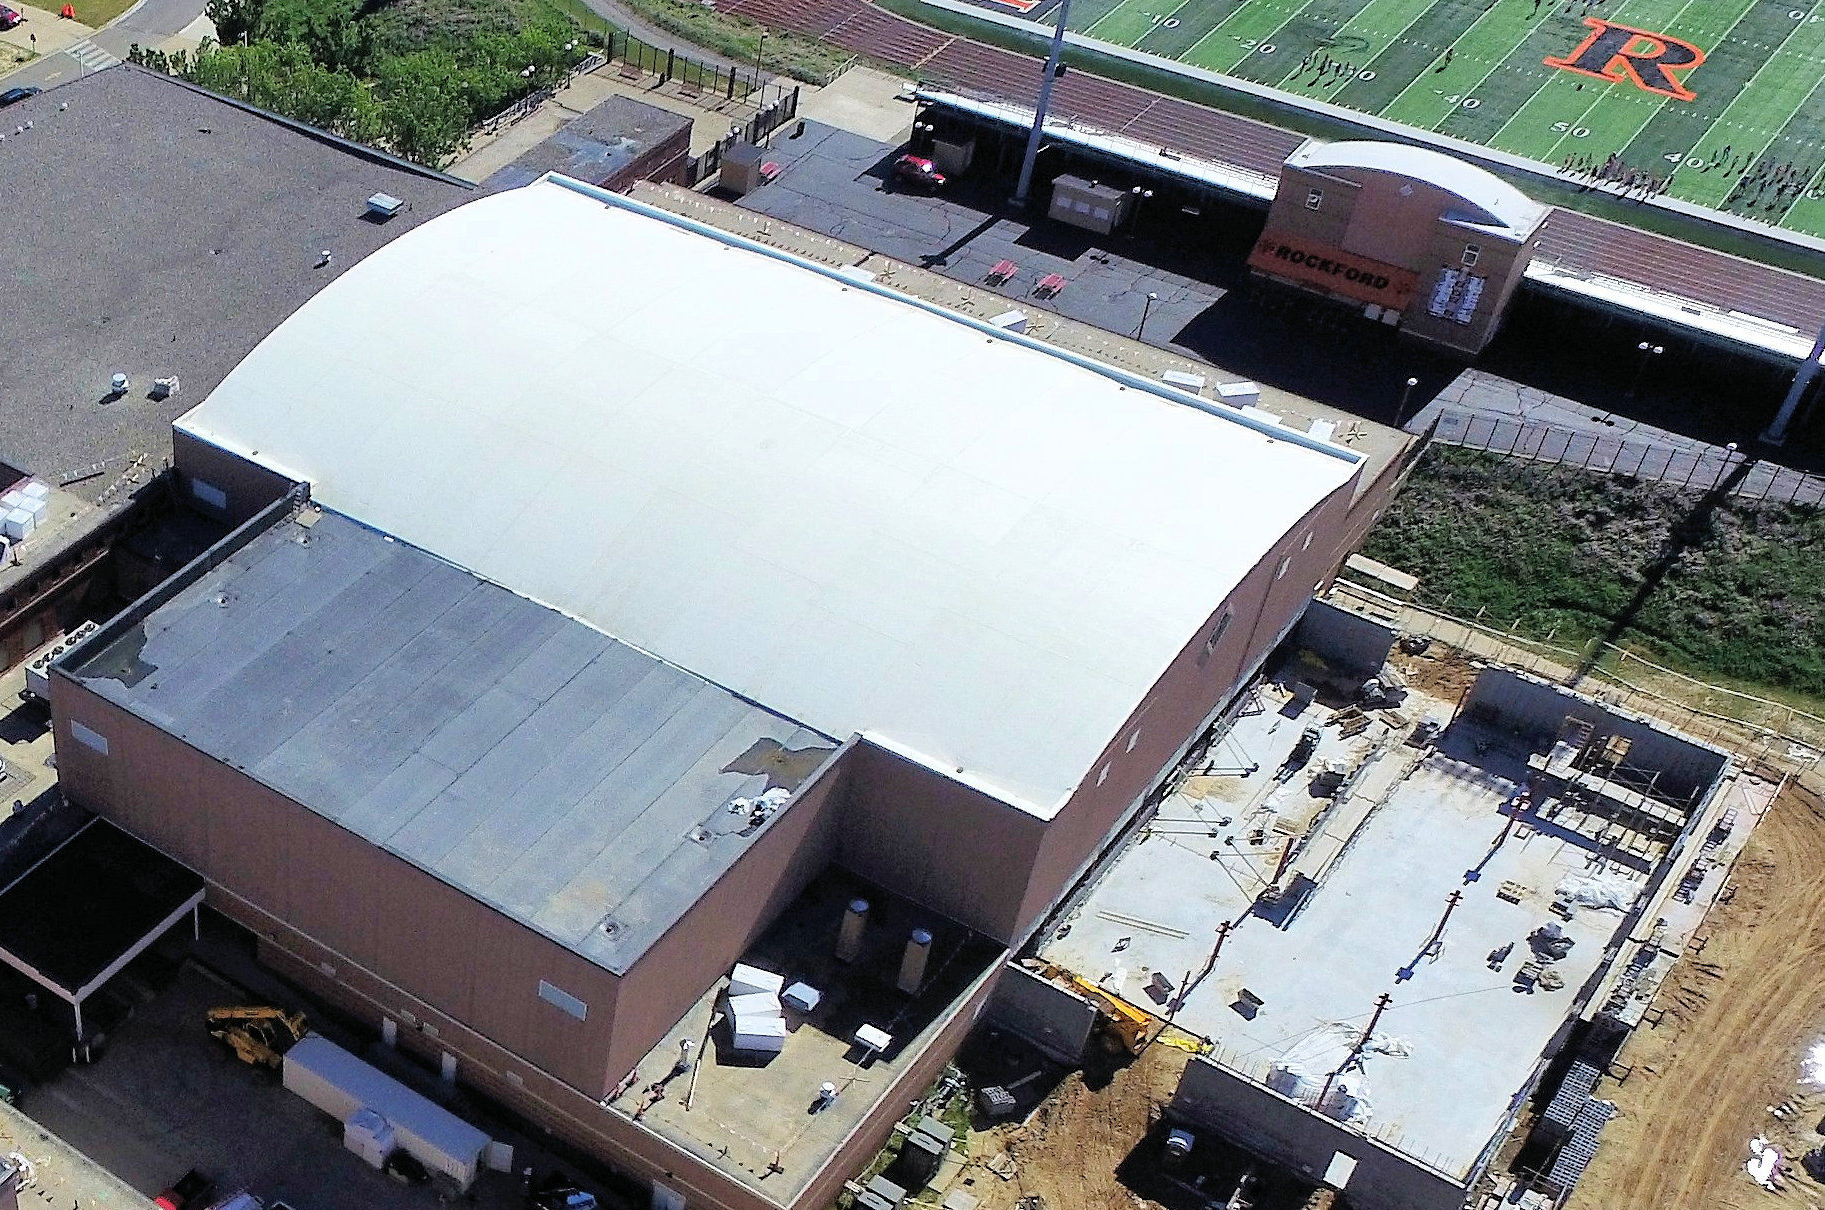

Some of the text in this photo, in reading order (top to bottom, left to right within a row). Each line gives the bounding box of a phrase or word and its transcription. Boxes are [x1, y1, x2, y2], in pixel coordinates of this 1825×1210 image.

[1543, 17, 1706, 102] R
[1549, 121, 1591, 138] 50
[1275, 245, 1390, 289] ROCKFORD
